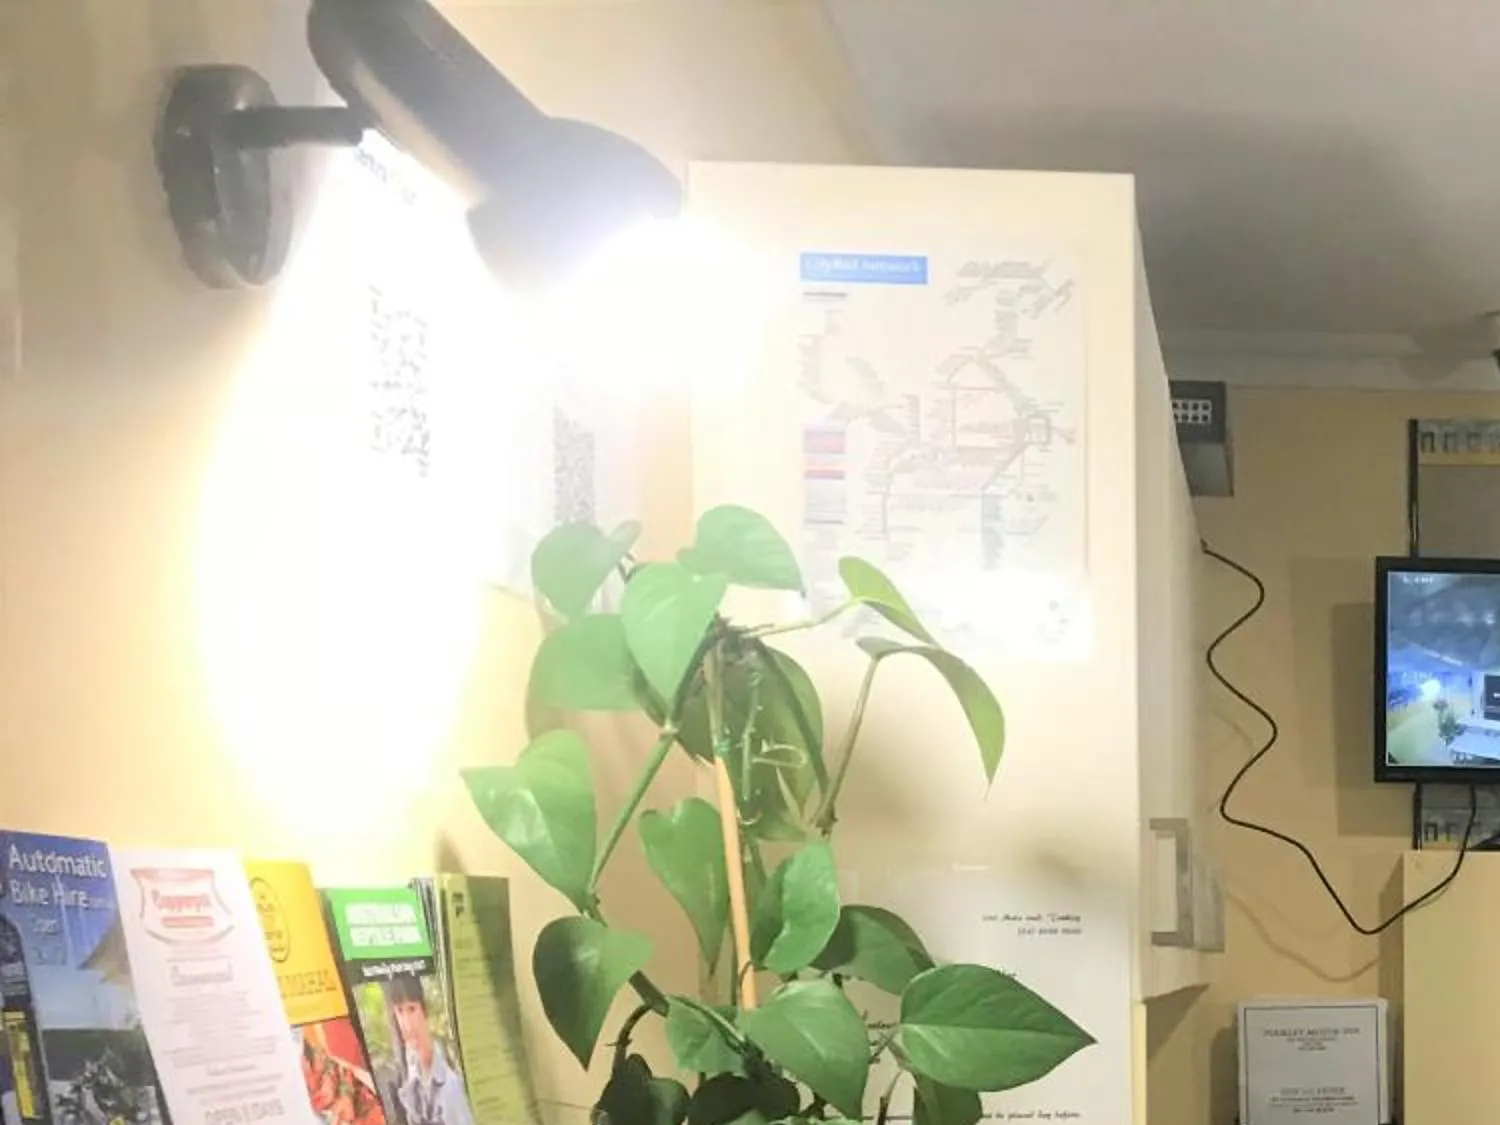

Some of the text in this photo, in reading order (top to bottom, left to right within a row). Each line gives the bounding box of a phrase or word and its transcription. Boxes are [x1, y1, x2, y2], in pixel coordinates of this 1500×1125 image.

[8, 844, 107, 878] Automatic
[10, 879, 49, 905] Bike
[51, 881, 88, 908] Hire
